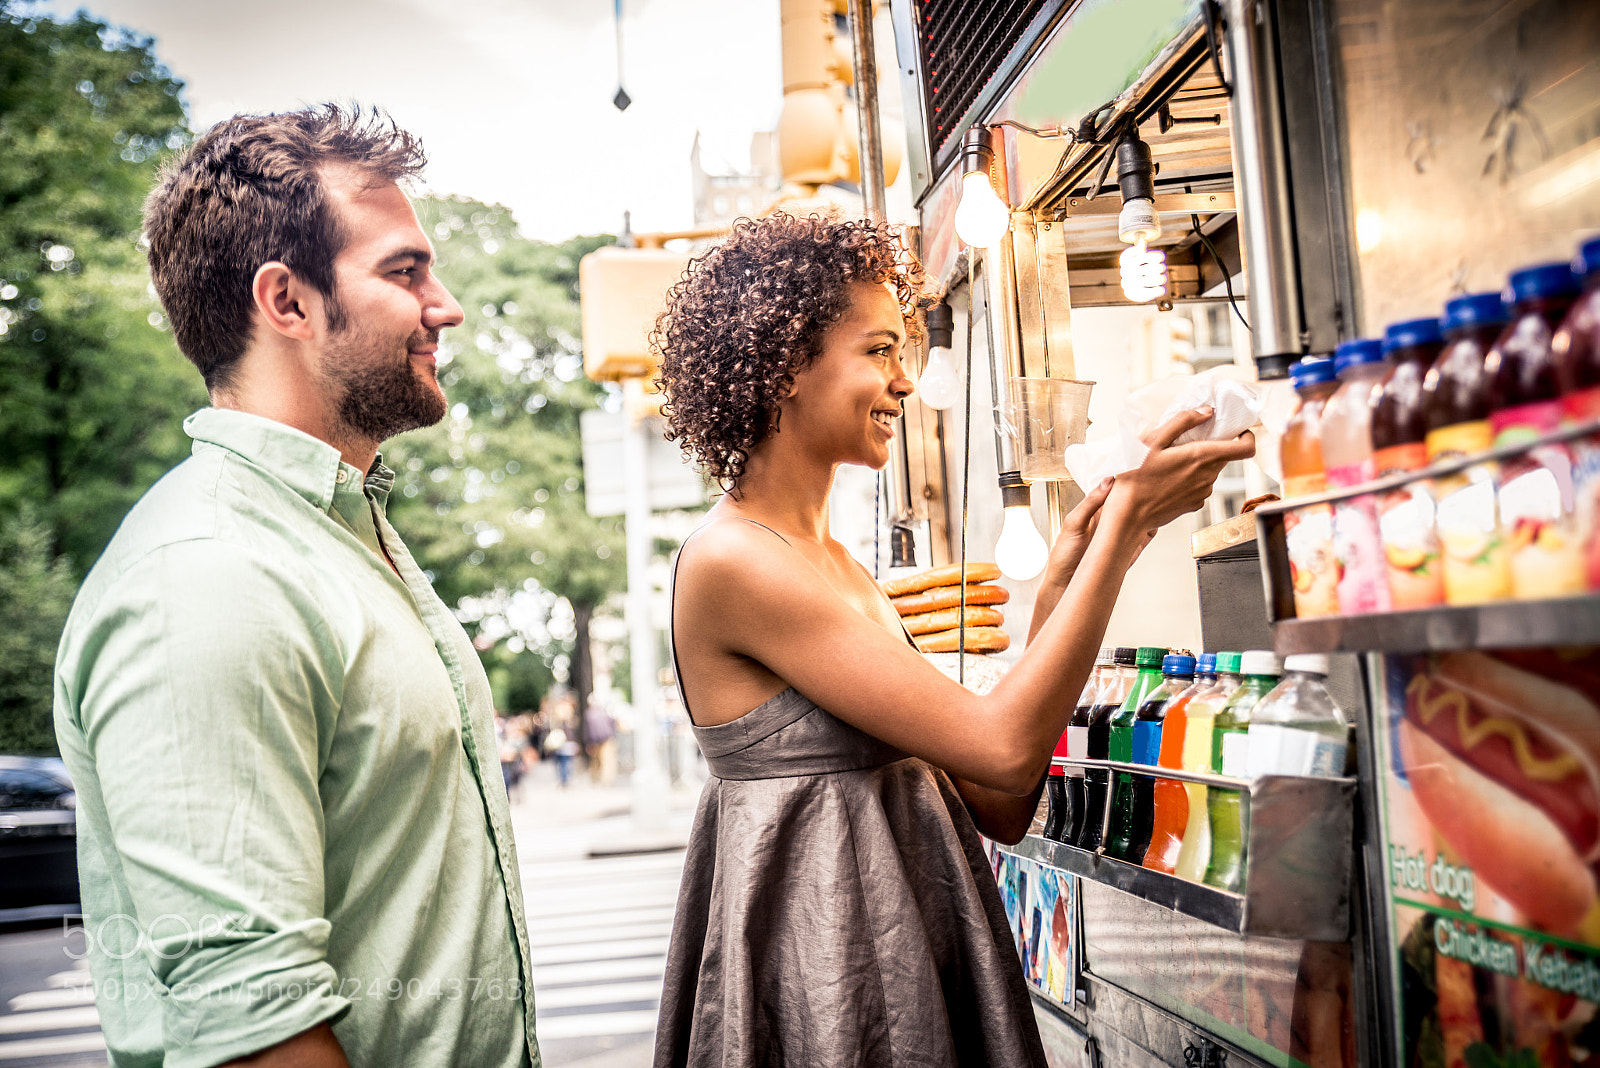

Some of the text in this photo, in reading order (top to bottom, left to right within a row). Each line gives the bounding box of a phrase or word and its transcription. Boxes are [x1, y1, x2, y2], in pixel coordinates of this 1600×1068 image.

[1390, 844, 1475, 913] Hot dog
[1434, 918, 1518, 977] Chicken
